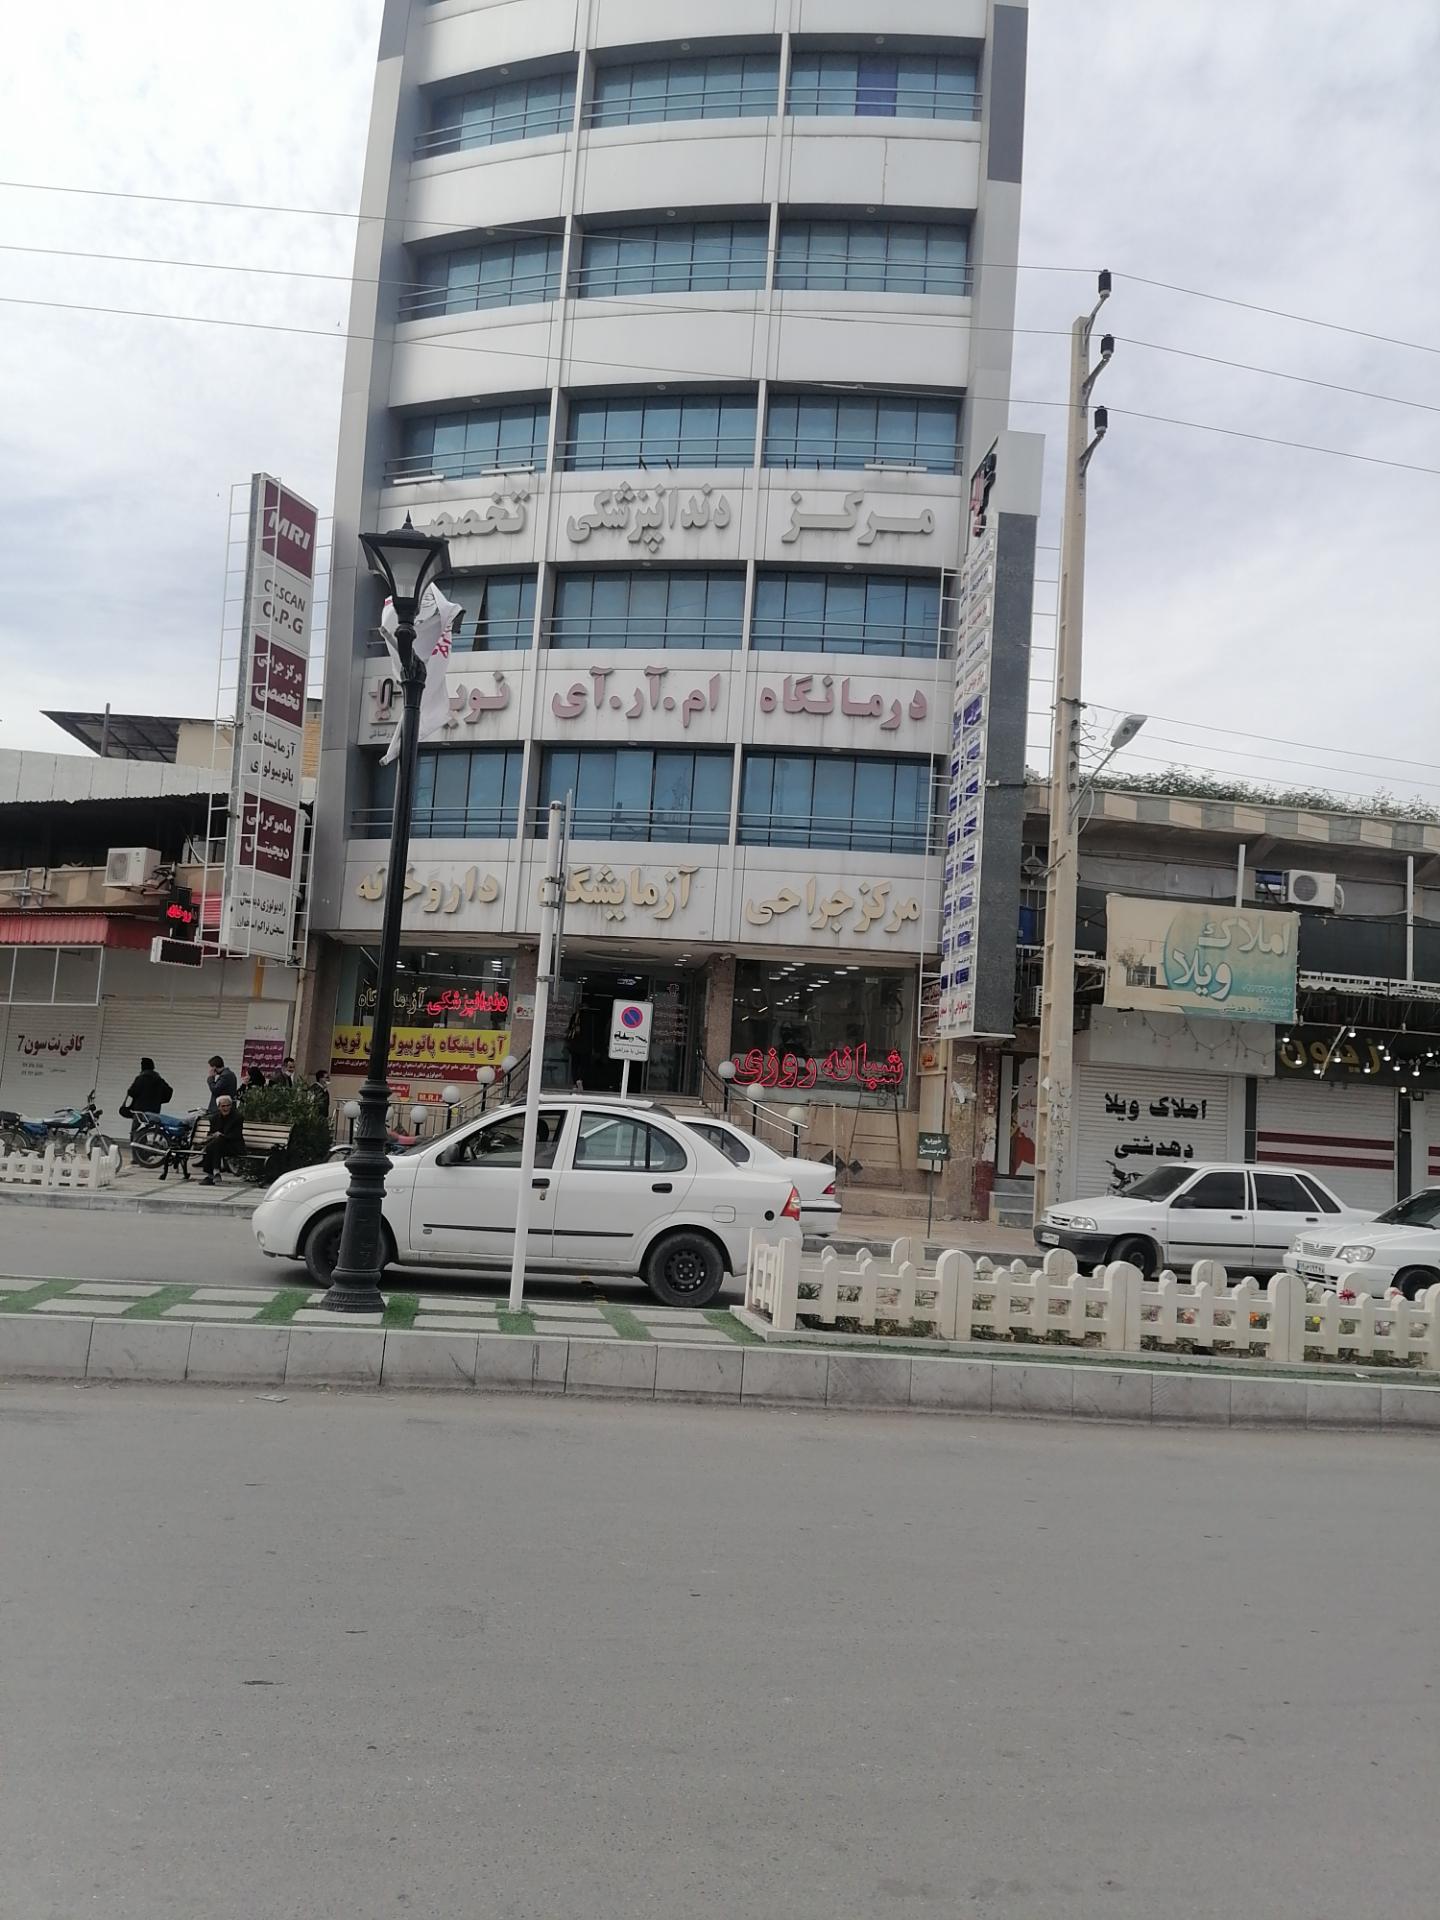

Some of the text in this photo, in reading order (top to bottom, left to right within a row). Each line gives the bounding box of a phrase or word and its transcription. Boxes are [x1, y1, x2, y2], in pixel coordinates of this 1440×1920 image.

[268, 511, 311, 550] MRI
[418, 490, 530, 537] تخصص
[566, 481, 731, 553] دندانپزشکی
[782, 490, 936, 546] مرکز
[262, 601, 304, 635] O.P.G
[264, 579, 306, 612] C.SCAN
[448, 671, 511, 730] نوی
[760, 674, 928, 730] درمانگاه
[250, 760, 294, 787] پاتوبیولوی
[246, 811, 292, 834] ماموگرای
[245, 836, 290, 861] دیجیتل
[356, 864, 499, 913] داروخنه
[538, 864, 700, 921] آزمایشگ
[745, 875, 855, 932] جراحی
[853, 880, 921, 932] مرکز
[1172, 948, 1234, 1000] ویلا
[17, 1033, 85, 1056] کافی نت سون 7
[364, 1032, 436, 1058] پاتوبیولی
[440, 1034, 507, 1060] آزمایشگاه
[731, 1041, 904, 1090] شبانه روزی
[1104, 1091, 1140, 1122] ویلا
